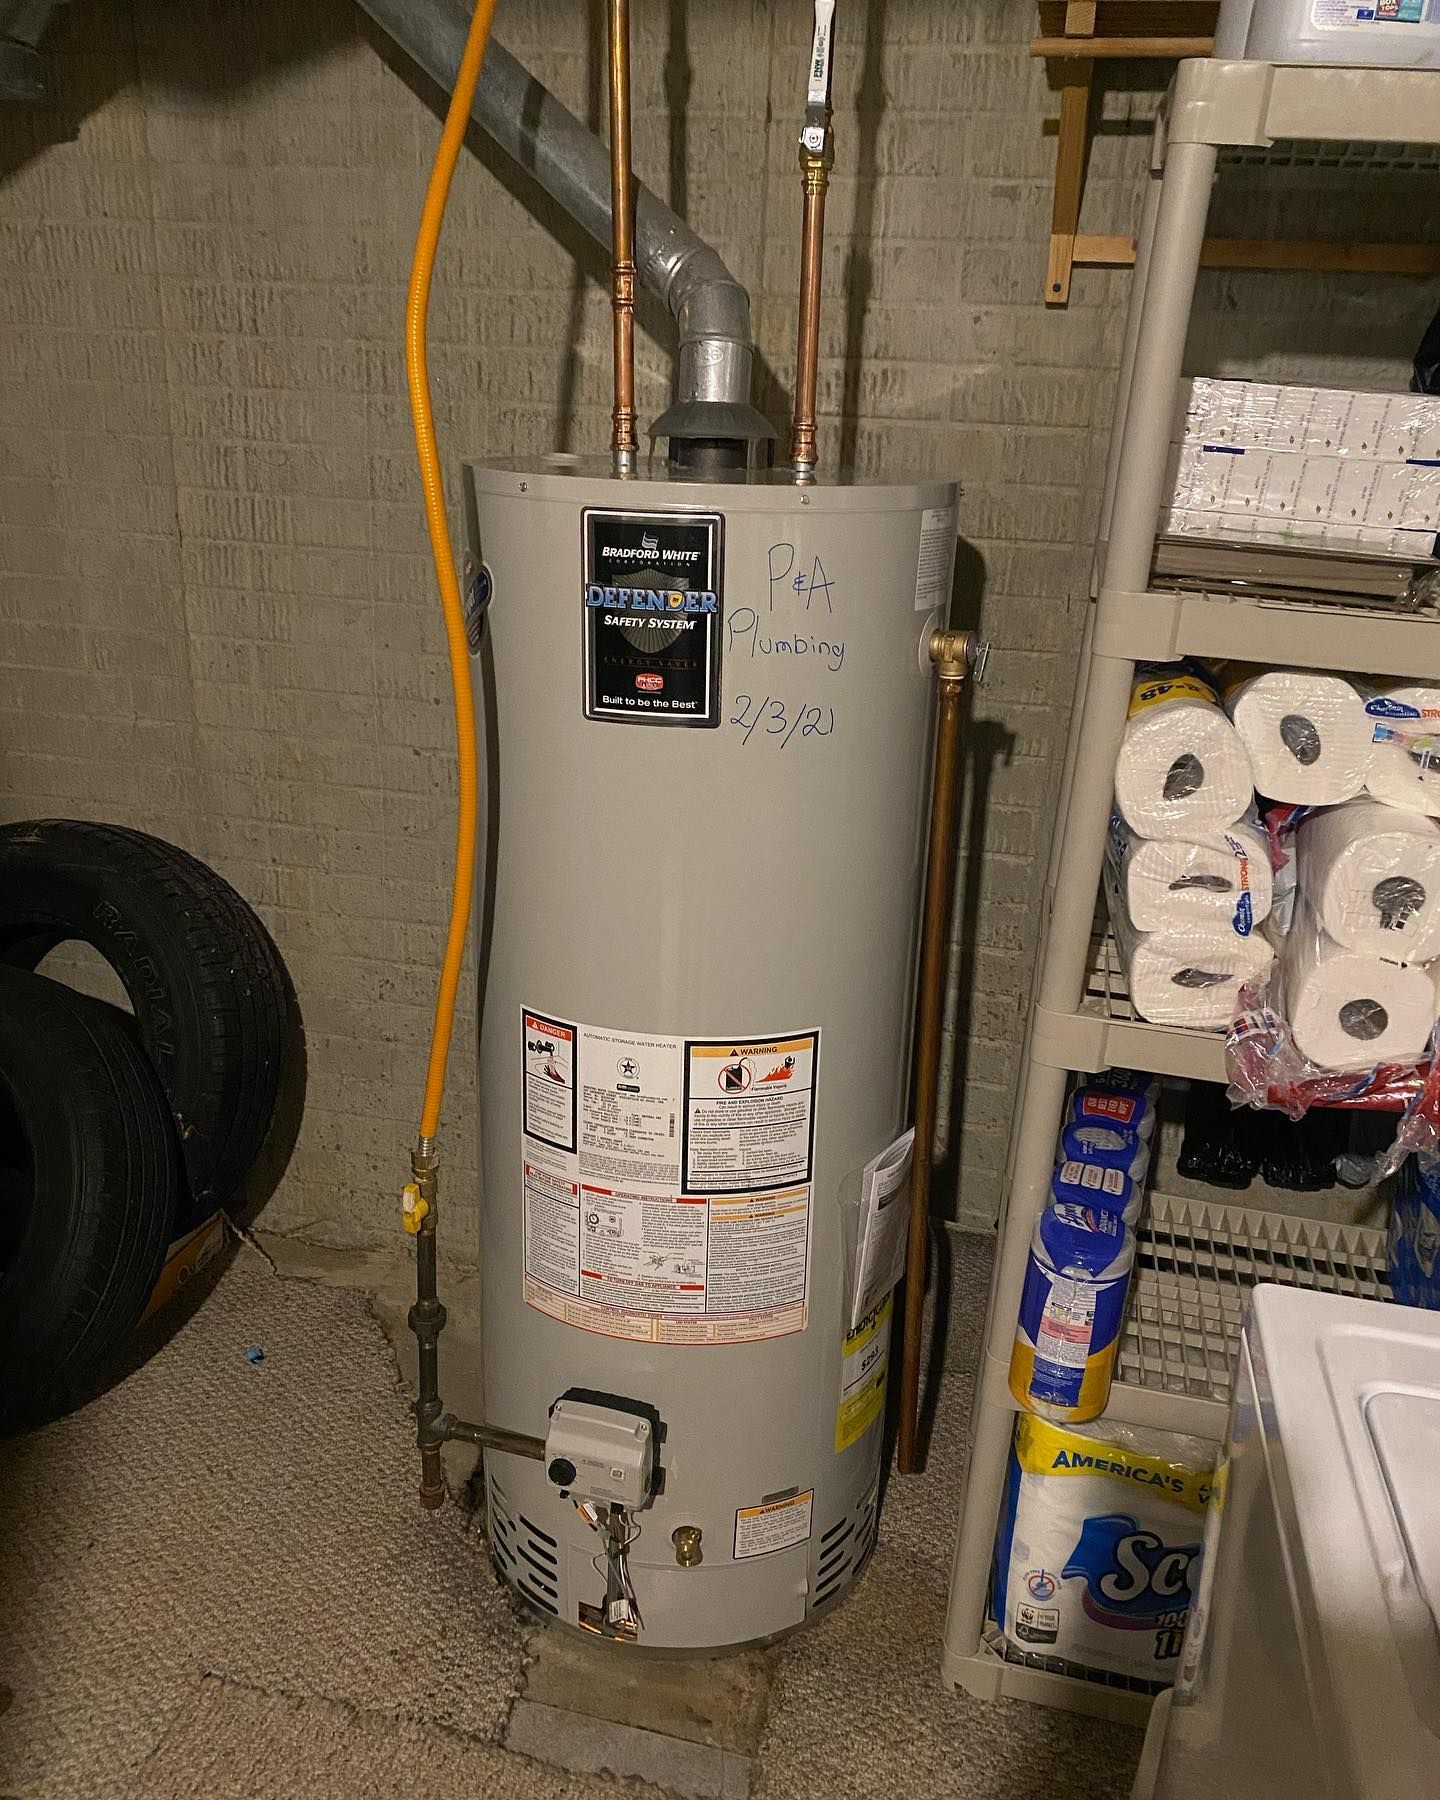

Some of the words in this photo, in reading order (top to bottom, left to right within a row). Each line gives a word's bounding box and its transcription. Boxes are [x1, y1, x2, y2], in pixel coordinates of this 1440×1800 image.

[602, 546, 660, 559] BRADFORD
[608, 558, 690, 567] CORPORATION
[587, 584, 717, 613] DEFENDER
[604, 614, 646, 628] SAFETY
[727, 607, 846, 672] Plumbing
[602, 695, 624, 706] Built
[625, 697, 636, 706] to
[637, 698, 651, 707] be
[652, 699, 670, 708] the
[730, 694, 835, 749] 2/3/21
[92, 900, 175, 1065] RADIAL
[539, 1023, 566, 1039] DANGER
[583, 1032, 611, 1042] AUTOMATIC
[611, 1038, 636, 1046] STORAGE
[740, 1046, 778, 1056] WARNING
[1051, 1449, 1185, 1493] AMERICA'S
[765, 1500, 795, 1513] WARNING
